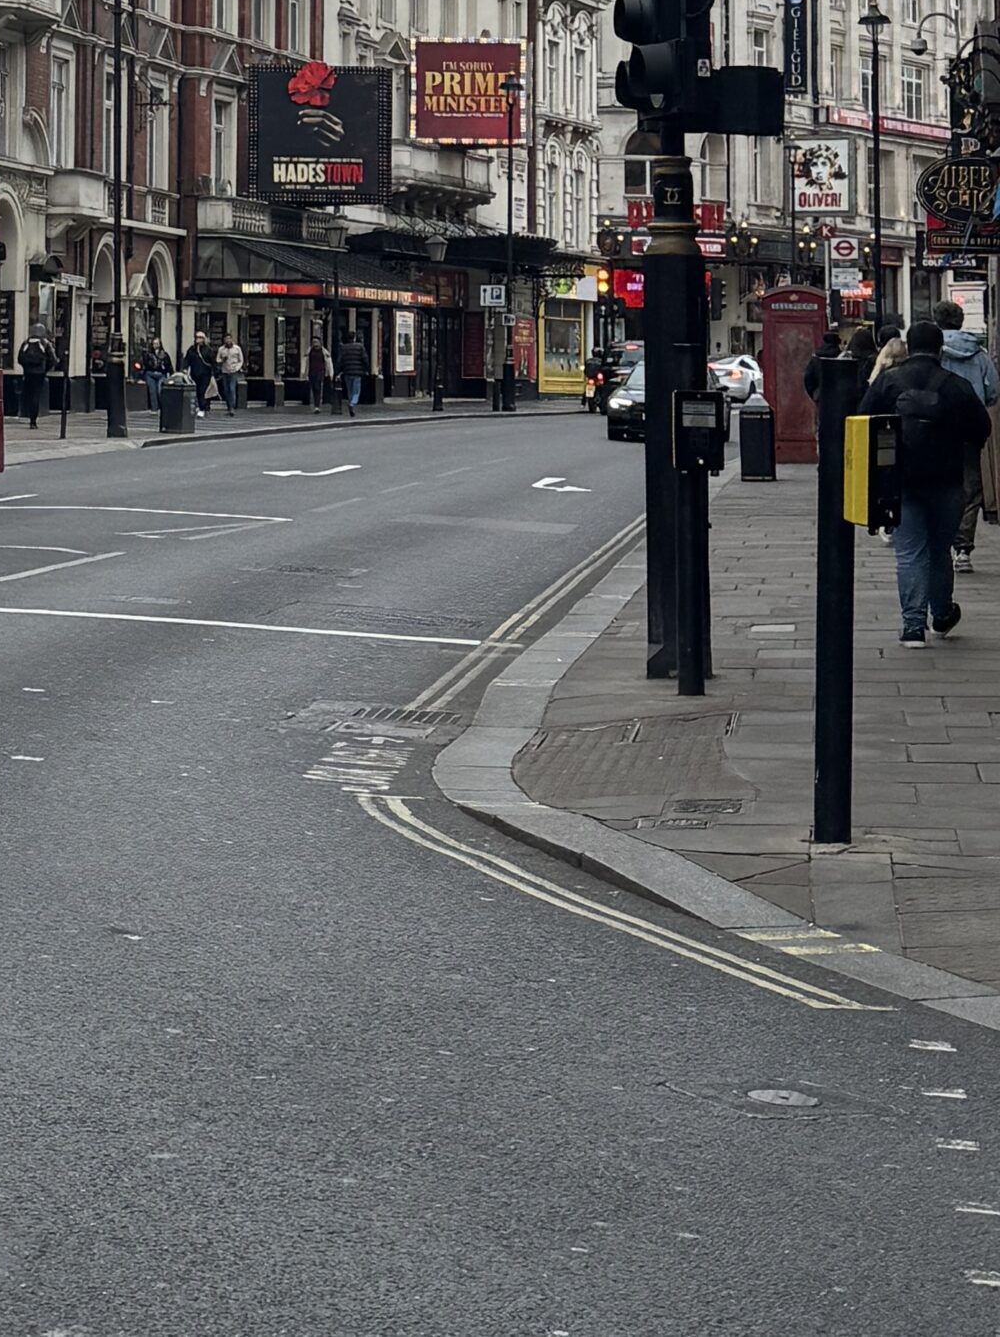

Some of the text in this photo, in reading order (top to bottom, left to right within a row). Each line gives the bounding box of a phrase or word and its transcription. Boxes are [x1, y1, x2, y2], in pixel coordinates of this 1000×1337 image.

[790, 6, 802, 87] GIELGUD
[442, 61, 494, 71] I'M SORRY
[273, 163, 363, 183] HADESTOWN
[798, 192, 842, 208] OLIVER!
[822, 225, 832, 237] K
[492, 288, 501, 300] P
